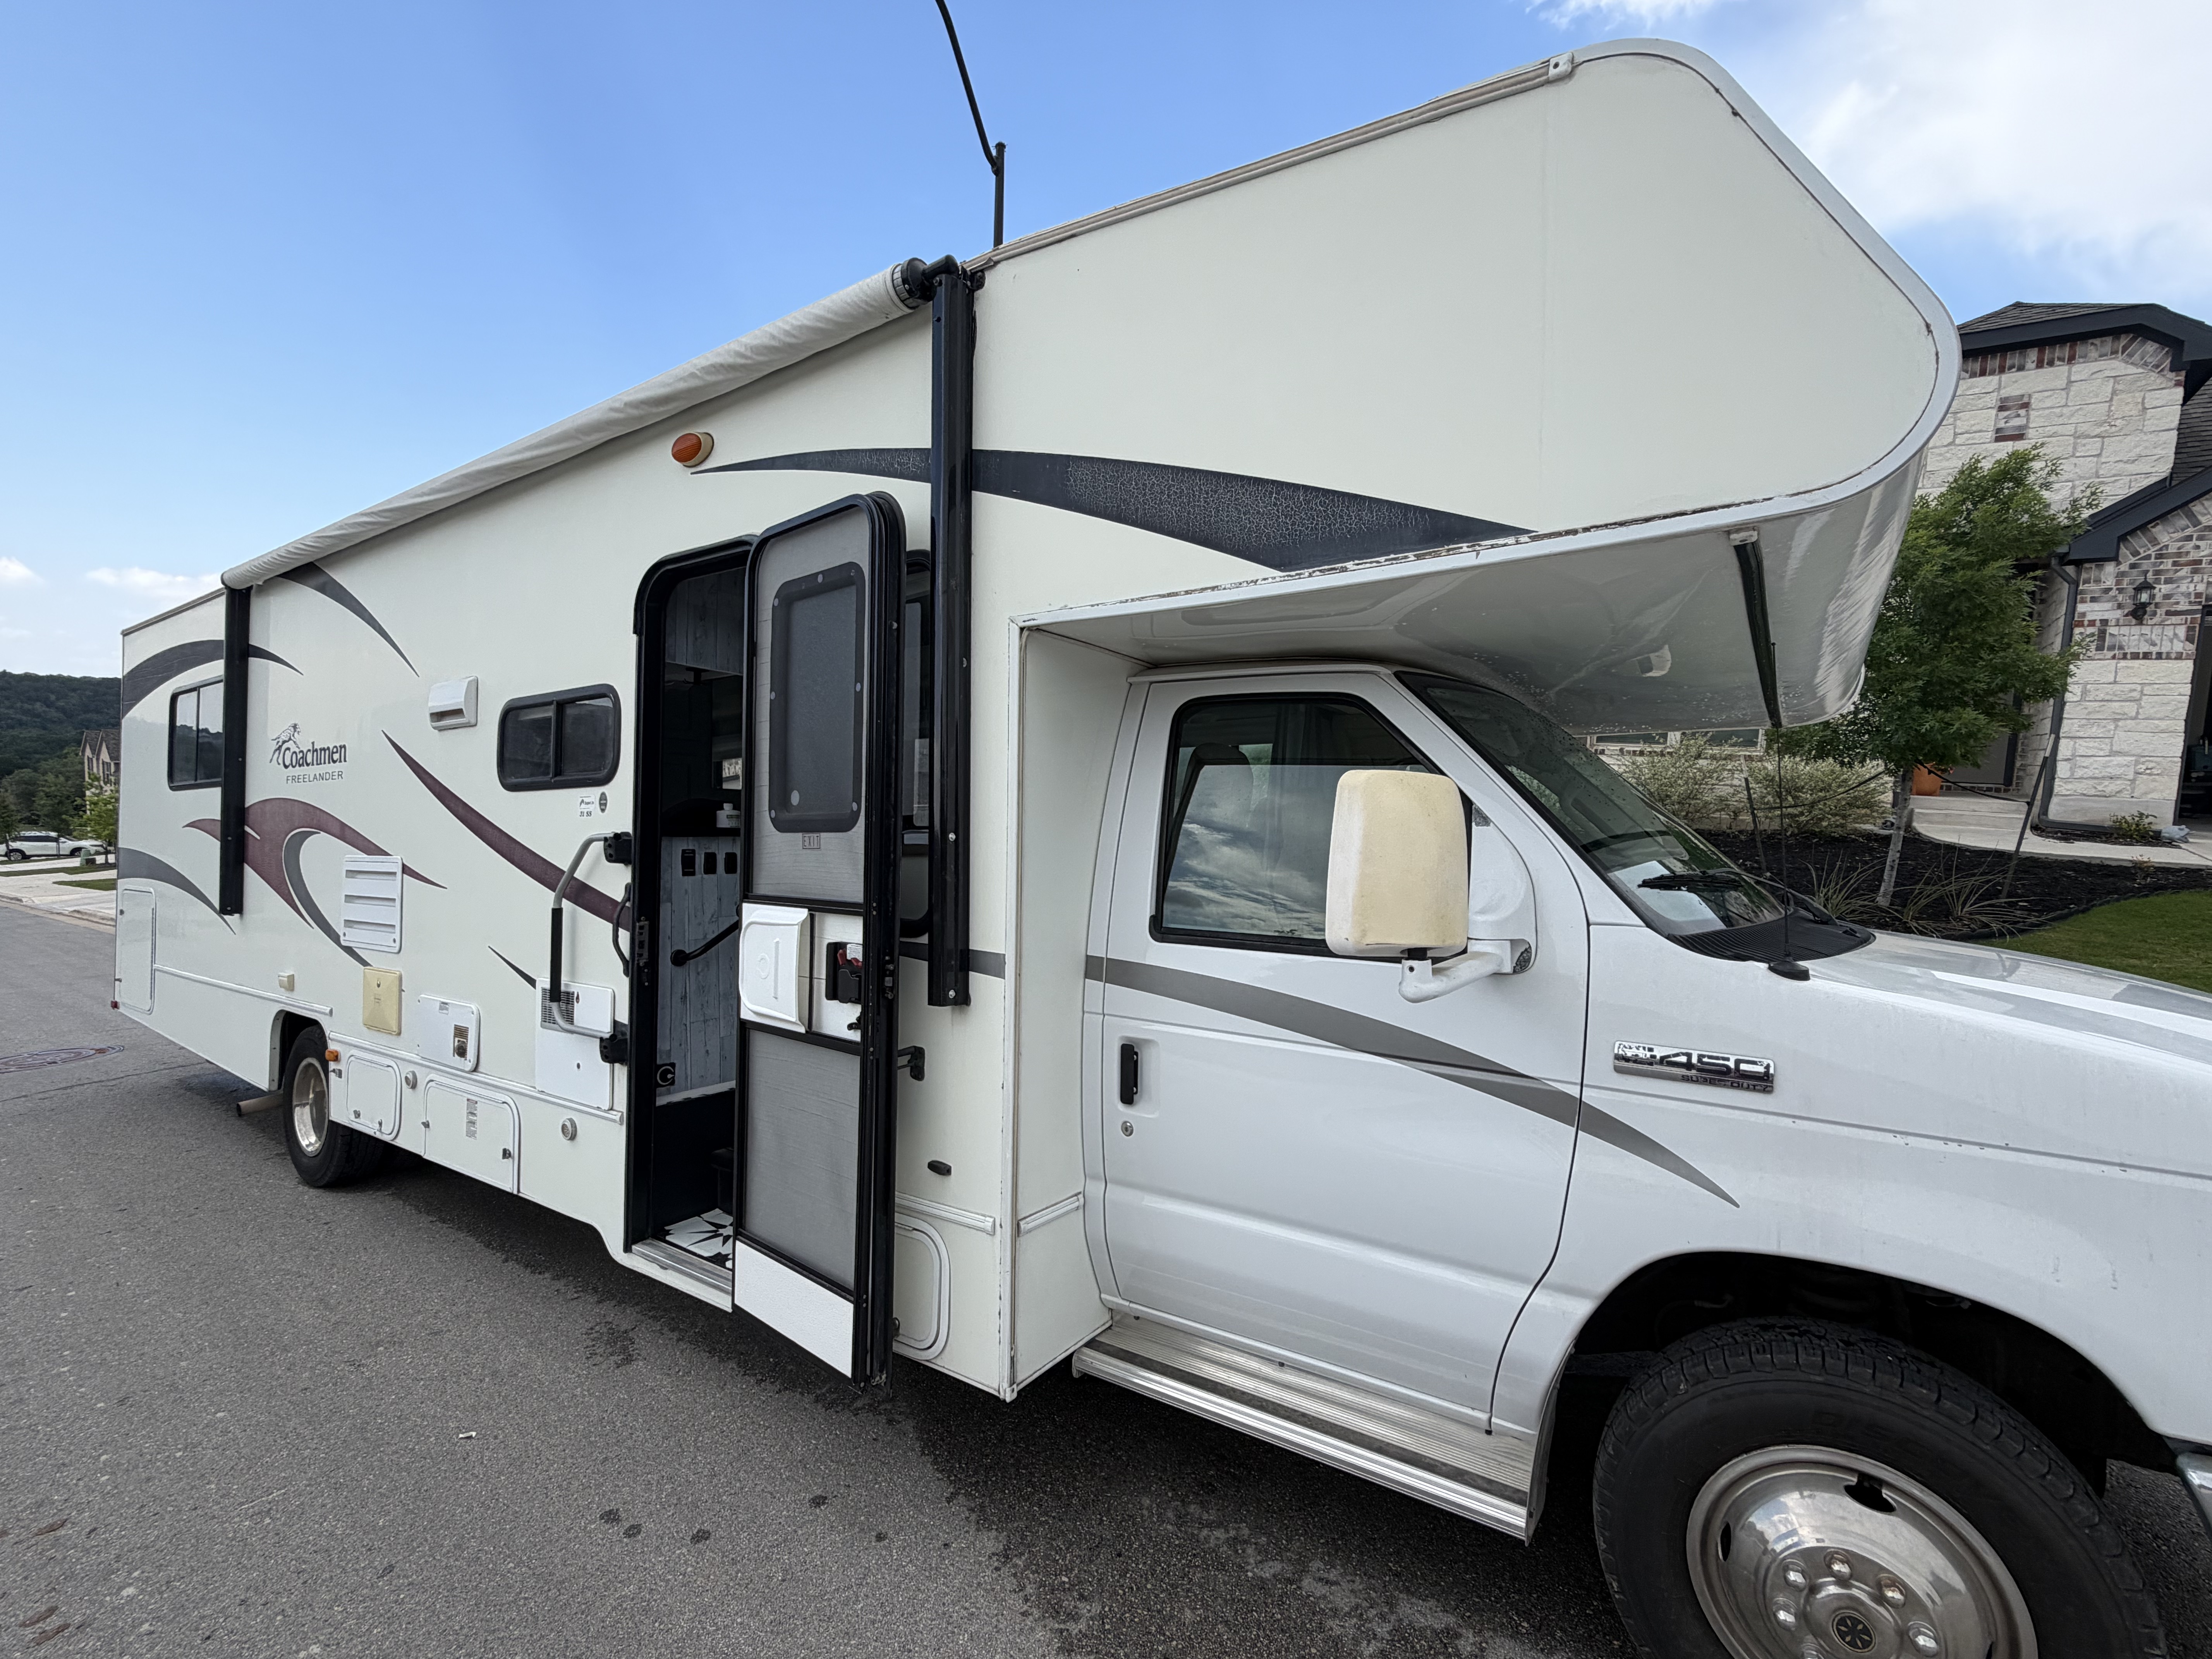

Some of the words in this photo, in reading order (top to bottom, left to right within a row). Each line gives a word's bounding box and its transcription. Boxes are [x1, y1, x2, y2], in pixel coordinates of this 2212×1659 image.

[282, 741, 347, 769] Coachmen
[286, 771, 343, 784] FREELANDER
[804, 835, 819, 847] EXIT
[1730, 1081, 1771, 1092] DUTY
